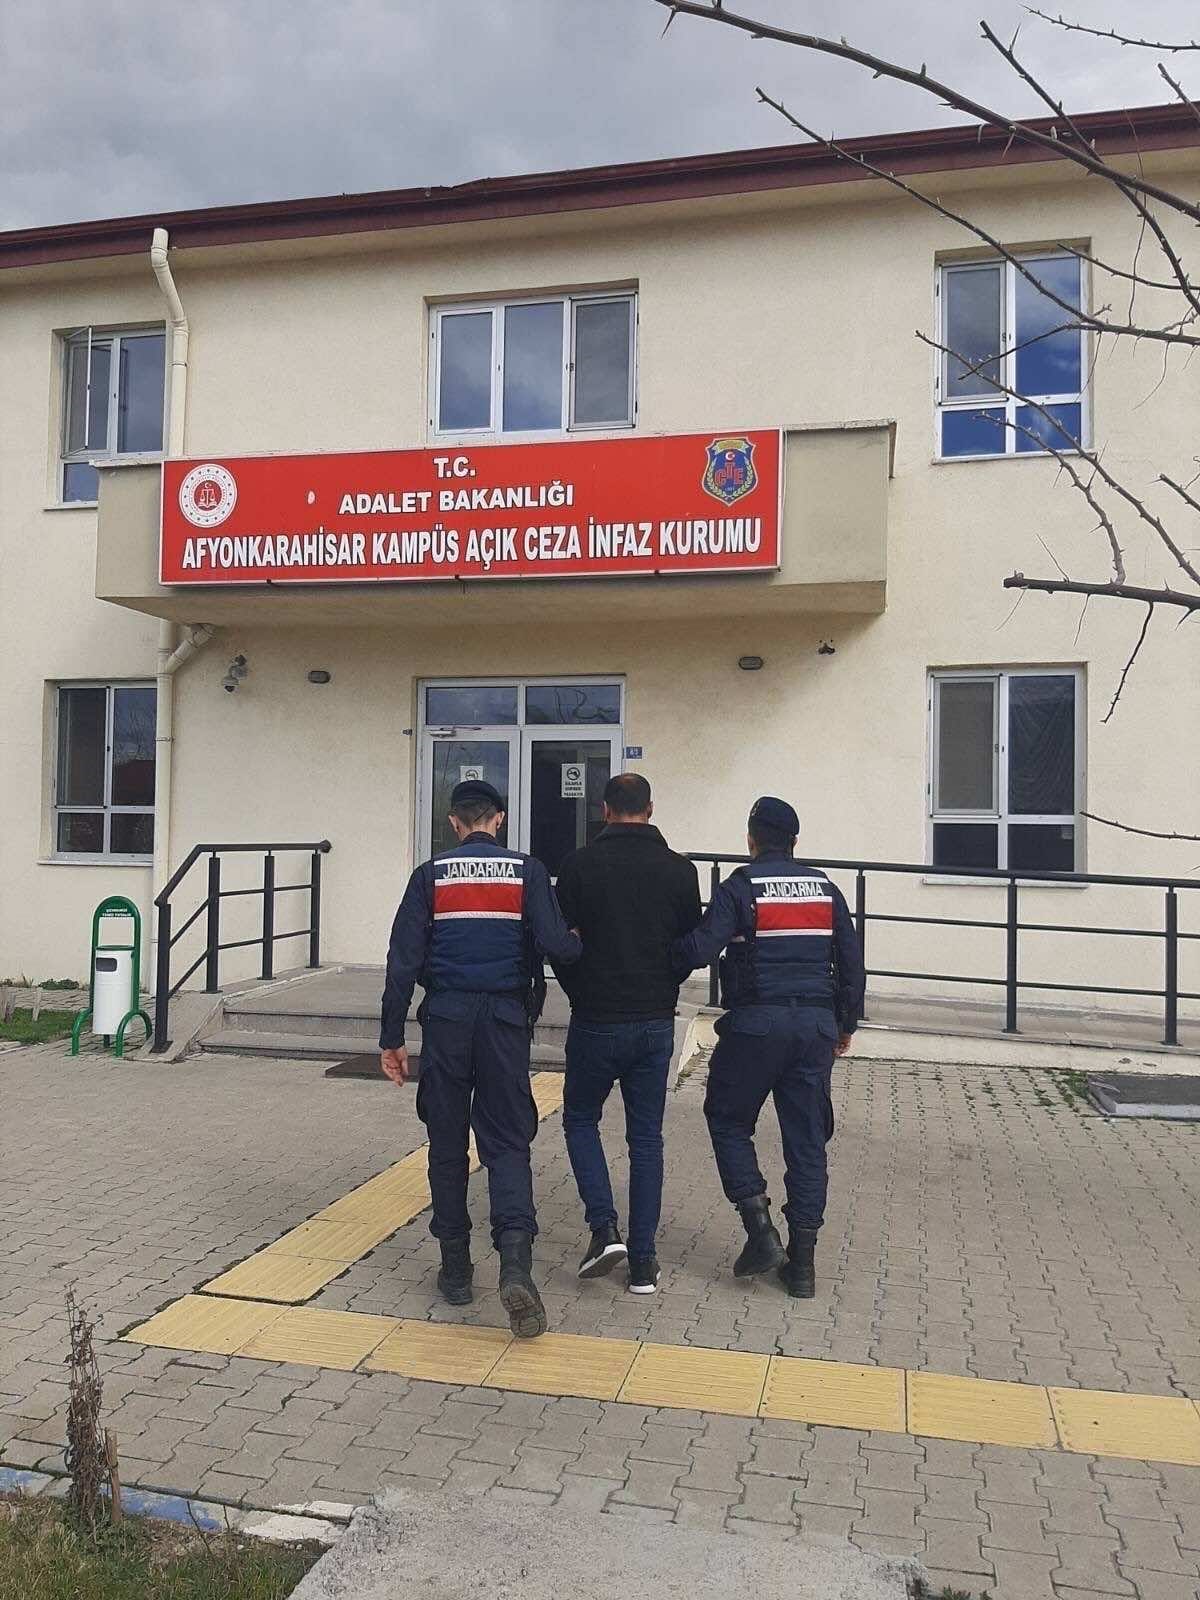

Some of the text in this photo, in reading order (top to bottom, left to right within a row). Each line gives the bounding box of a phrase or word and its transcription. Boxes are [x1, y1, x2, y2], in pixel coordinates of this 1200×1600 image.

[433, 456, 477, 478] T.C.
[338, 481, 575, 515] ADALET BAKANLIĞI
[182, 517, 762, 570] AFYONKARAHİSAR KAMPÜS AÇIK CEZA İNFAZ KURUMU
[442, 862, 516, 879] JANDARMA
[762, 882, 825, 897] JANDARMA
